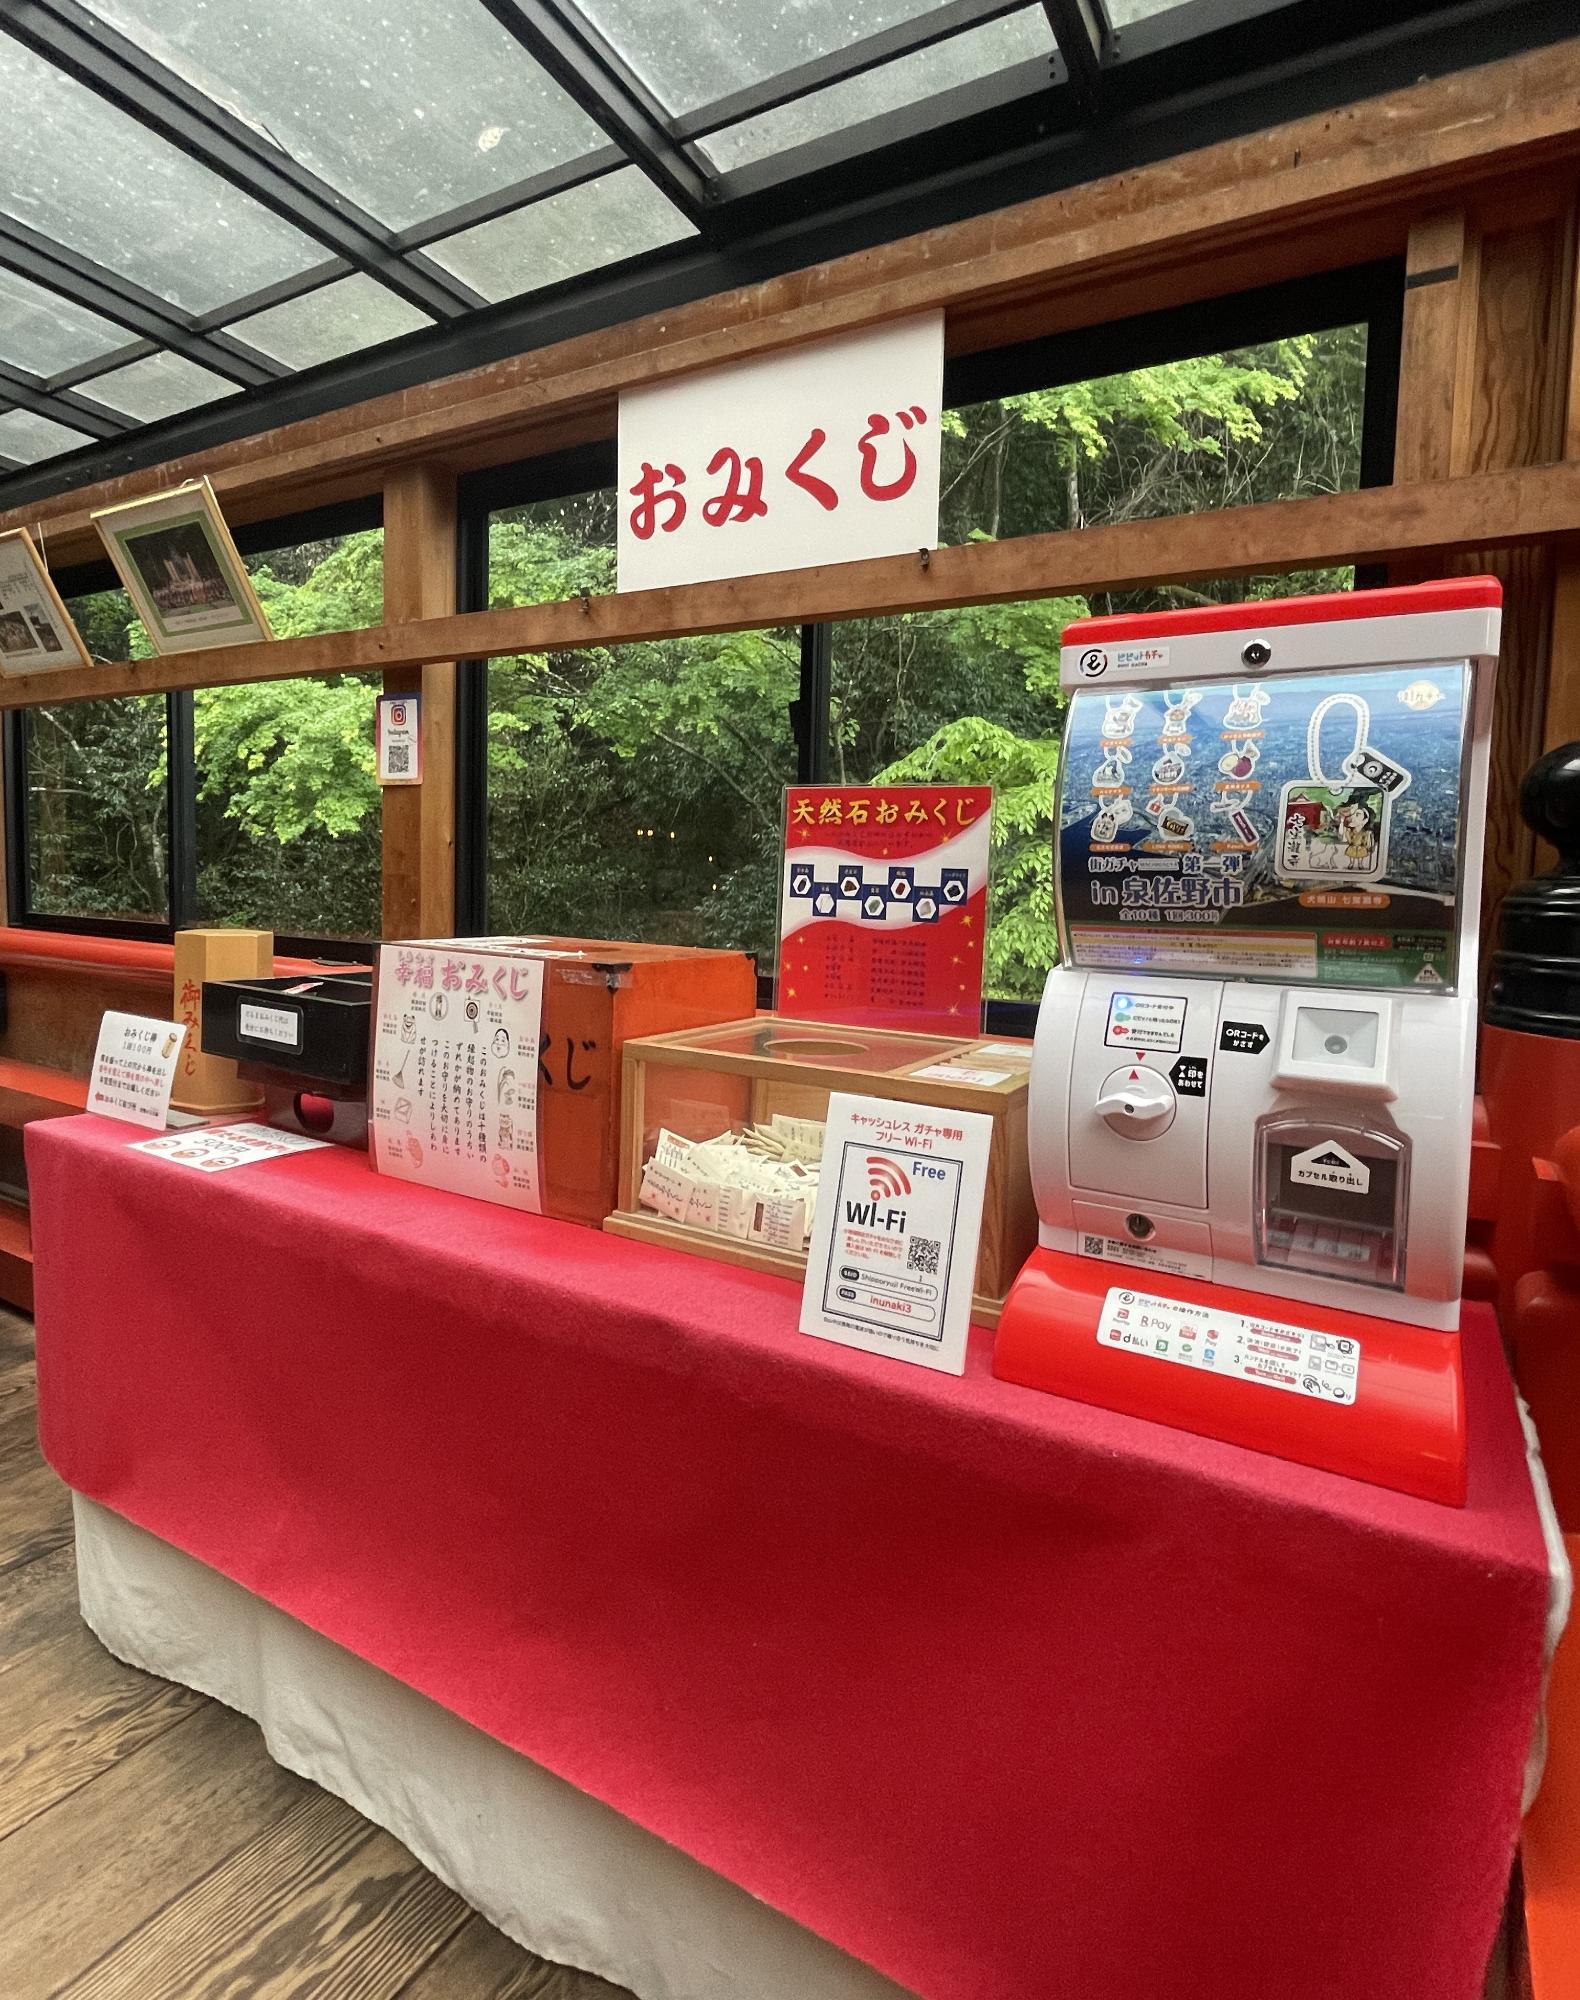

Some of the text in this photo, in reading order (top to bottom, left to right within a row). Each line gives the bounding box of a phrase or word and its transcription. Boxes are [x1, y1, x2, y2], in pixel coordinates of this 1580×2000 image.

[630, 406, 927, 540] おみくじ
[792, 798, 975, 826] 天然石おみくじ
[1088, 853, 1243, 874] 街ガチャ 第一弾
[1091, 875, 1244, 908] in 泉佐野市
[394, 961, 529, 1001] 幸福 おみくじ
[179, 979, 200, 1077] 御みくじ
[1225, 1028, 1264, 1041] QRコードを
[1232, 1039, 1254, 1049] かざす
[417, 1036, 428, 1098] せが訪れます
[1187, 1069, 1204, 1079] 印を
[429, 1039, 439, 1152] つけることによりしあわ
[440, 1040, 451, 1155] このお守りを大切に身に
[1177, 1079, 1204, 1089] あわせて
[465, 1043, 476, 1159] 縁起物のお守りのうちい
[478, 1045, 488, 1163] このおみくじは十種類の
[850, 1113, 964, 1142] キャッシュレス ガチャ専用
[875, 1131, 902, 1143] フリー
[912, 1161, 946, 1181] Free
[1297, 1170, 1364, 1187] カプセル取り出し
[846, 1200, 907, 1234] Wi-Fi
[870, 1296, 912, 1314] inunaki3
[1150, 1316, 1172, 1332] Pay
